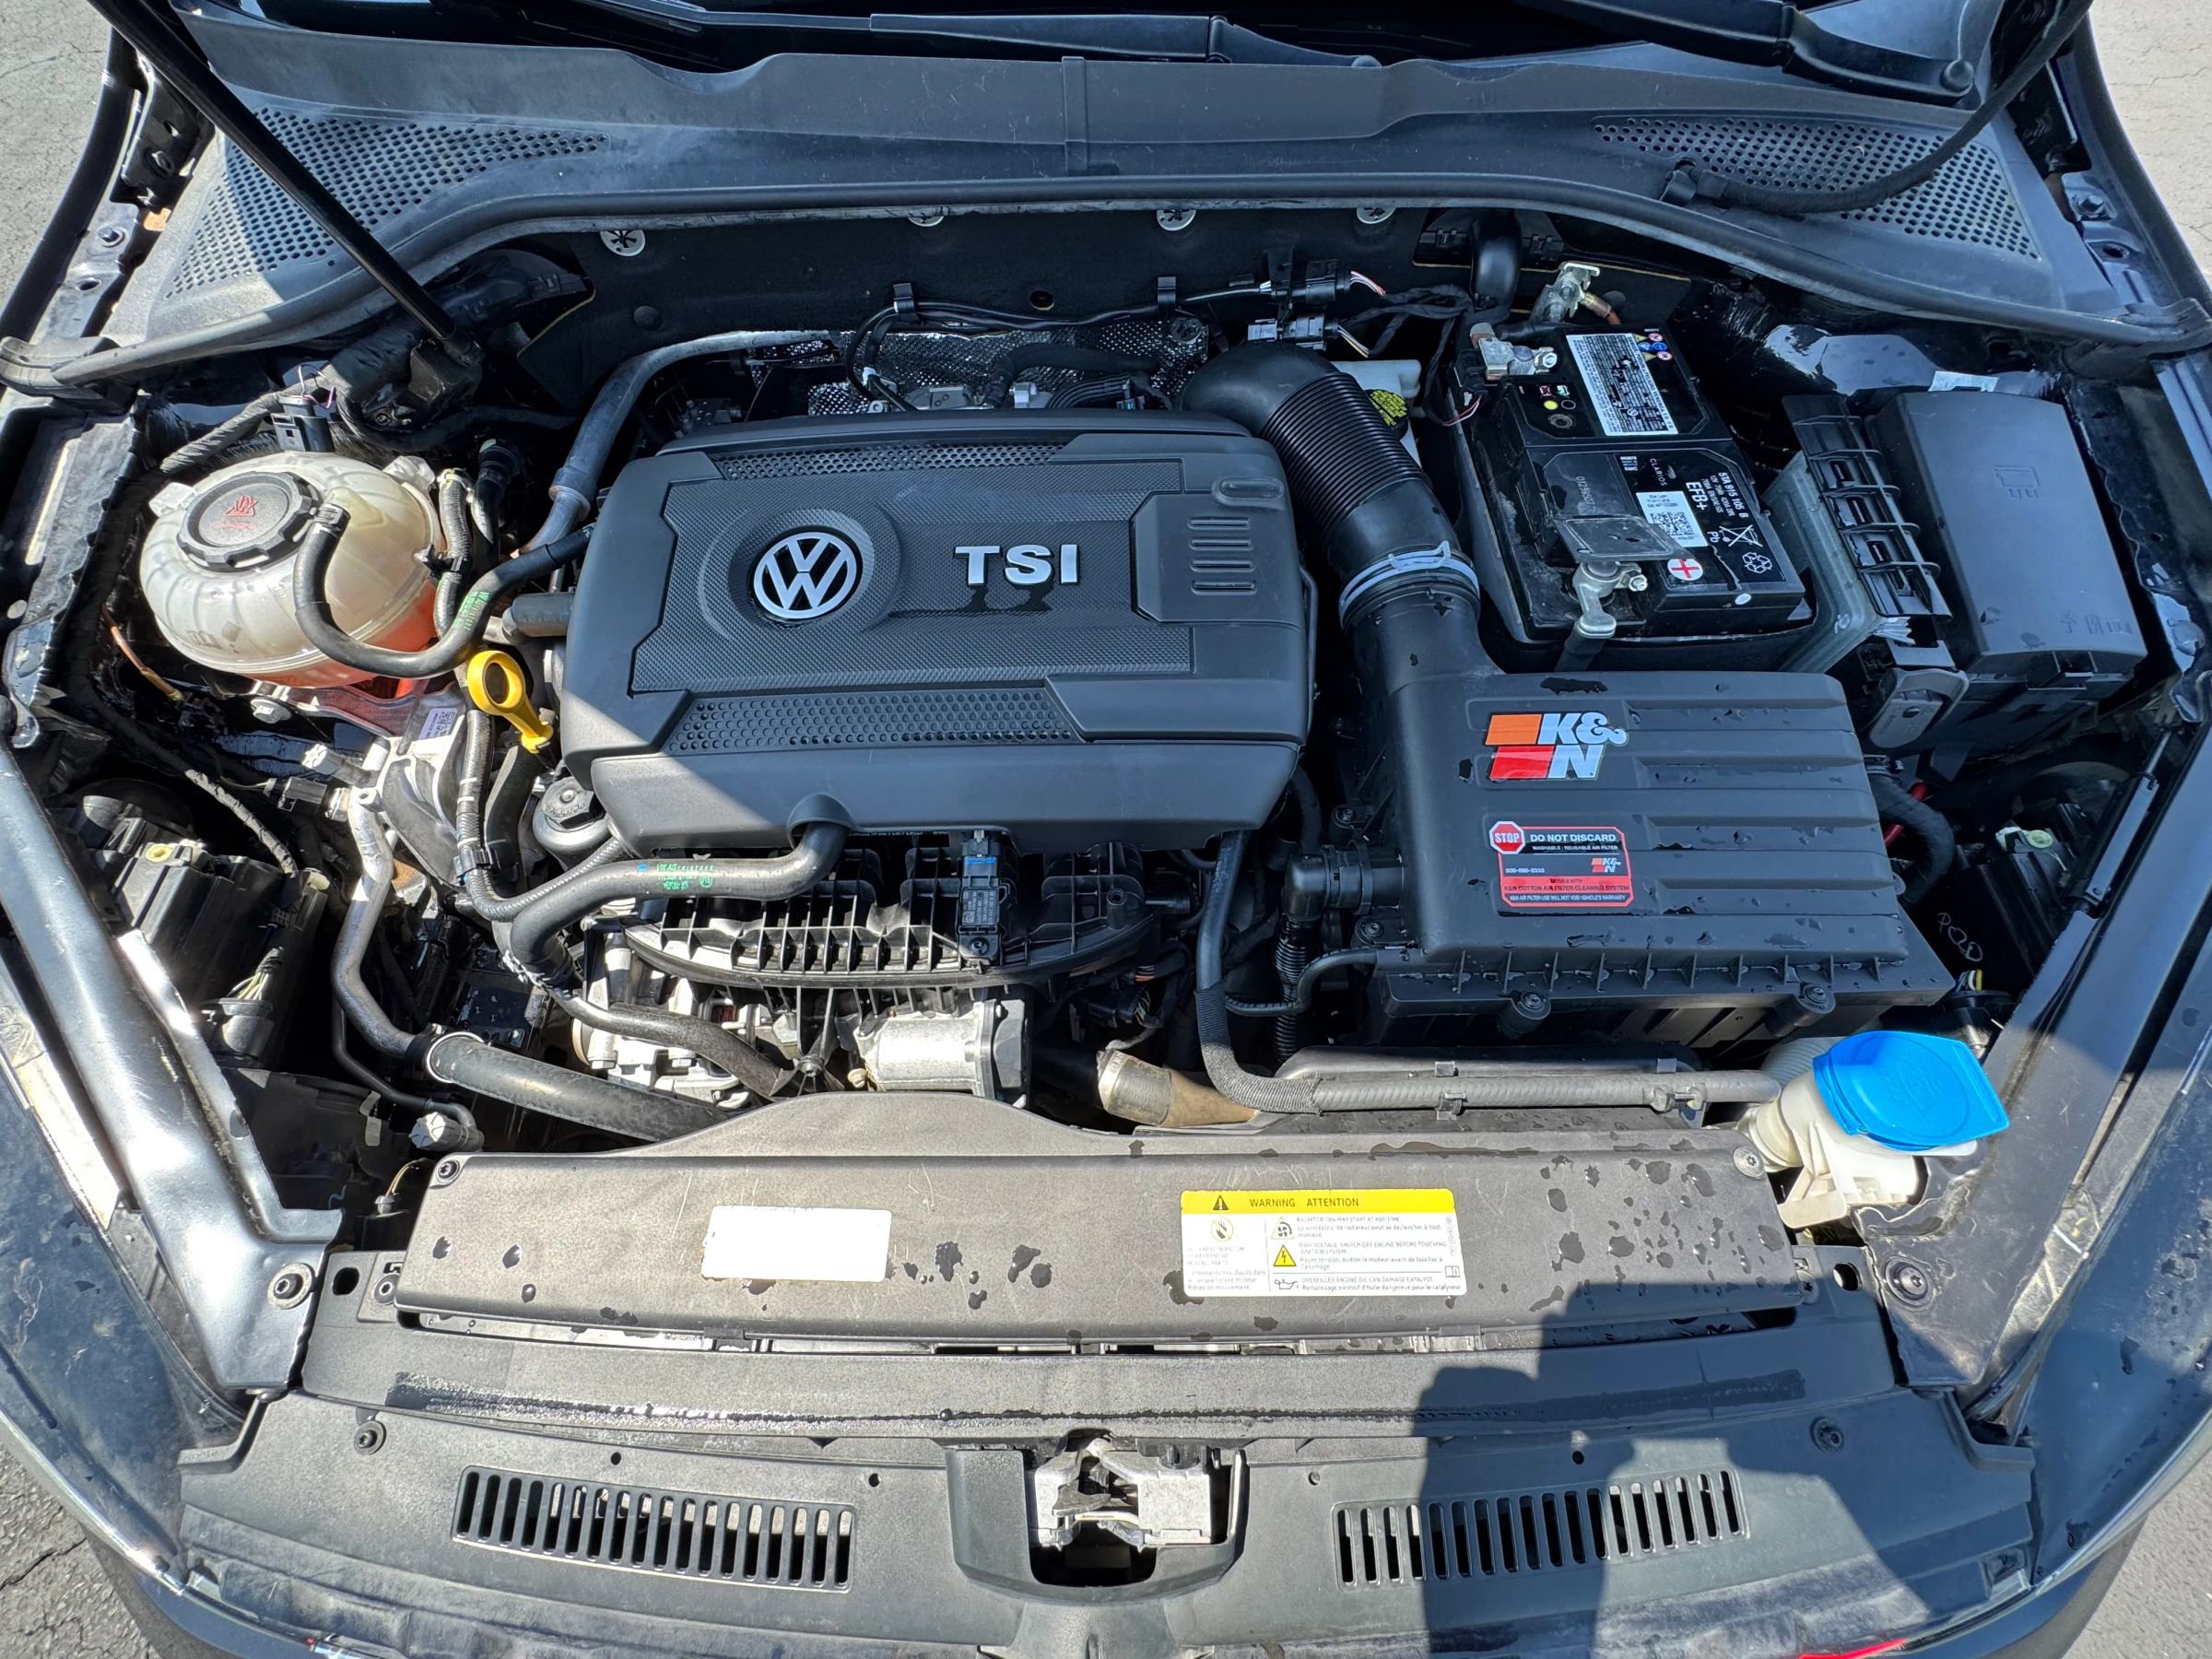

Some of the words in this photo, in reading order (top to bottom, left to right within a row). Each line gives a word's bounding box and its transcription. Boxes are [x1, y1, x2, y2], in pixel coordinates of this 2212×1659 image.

[1650, 458, 1668, 486] CLARIOS
[1718, 472, 1731, 484] 5TA
[1686, 482, 1708, 510] EFB+
[1724, 485, 1738, 497] 915
[1732, 498, 1745, 510] 105
[1707, 531, 1720, 542] Pb
[955, 544, 1078, 585] TSI
[753, 531, 857, 619] VW
[1494, 833, 1519, 843] STOP
[1570, 834, 1616, 842] DISCARD
[1249, 1198, 1295, 1207] WARNING
[1307, 1198, 1359, 1207] ATTENTION
